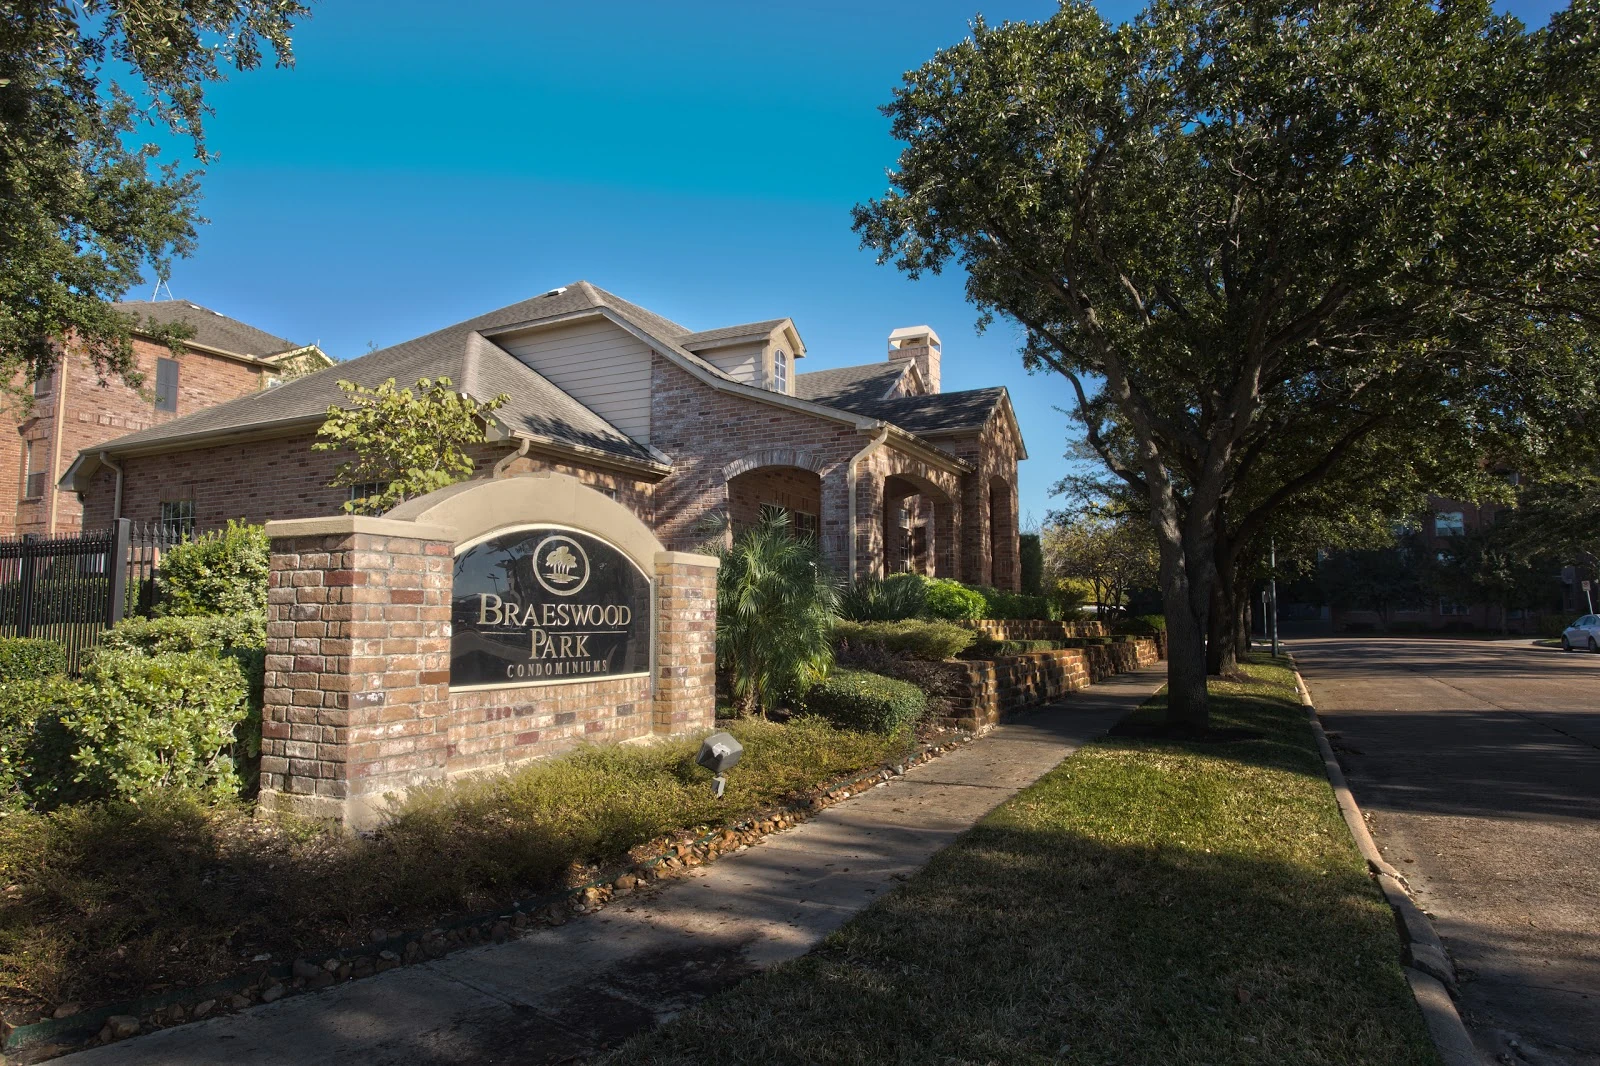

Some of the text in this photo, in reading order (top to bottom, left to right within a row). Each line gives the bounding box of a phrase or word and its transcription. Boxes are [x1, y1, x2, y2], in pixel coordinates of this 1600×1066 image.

[476, 593, 632, 627] BRAESWOOD
[529, 628, 591, 660] PARK
[507, 659, 607, 678] CONDOMINIUMS
